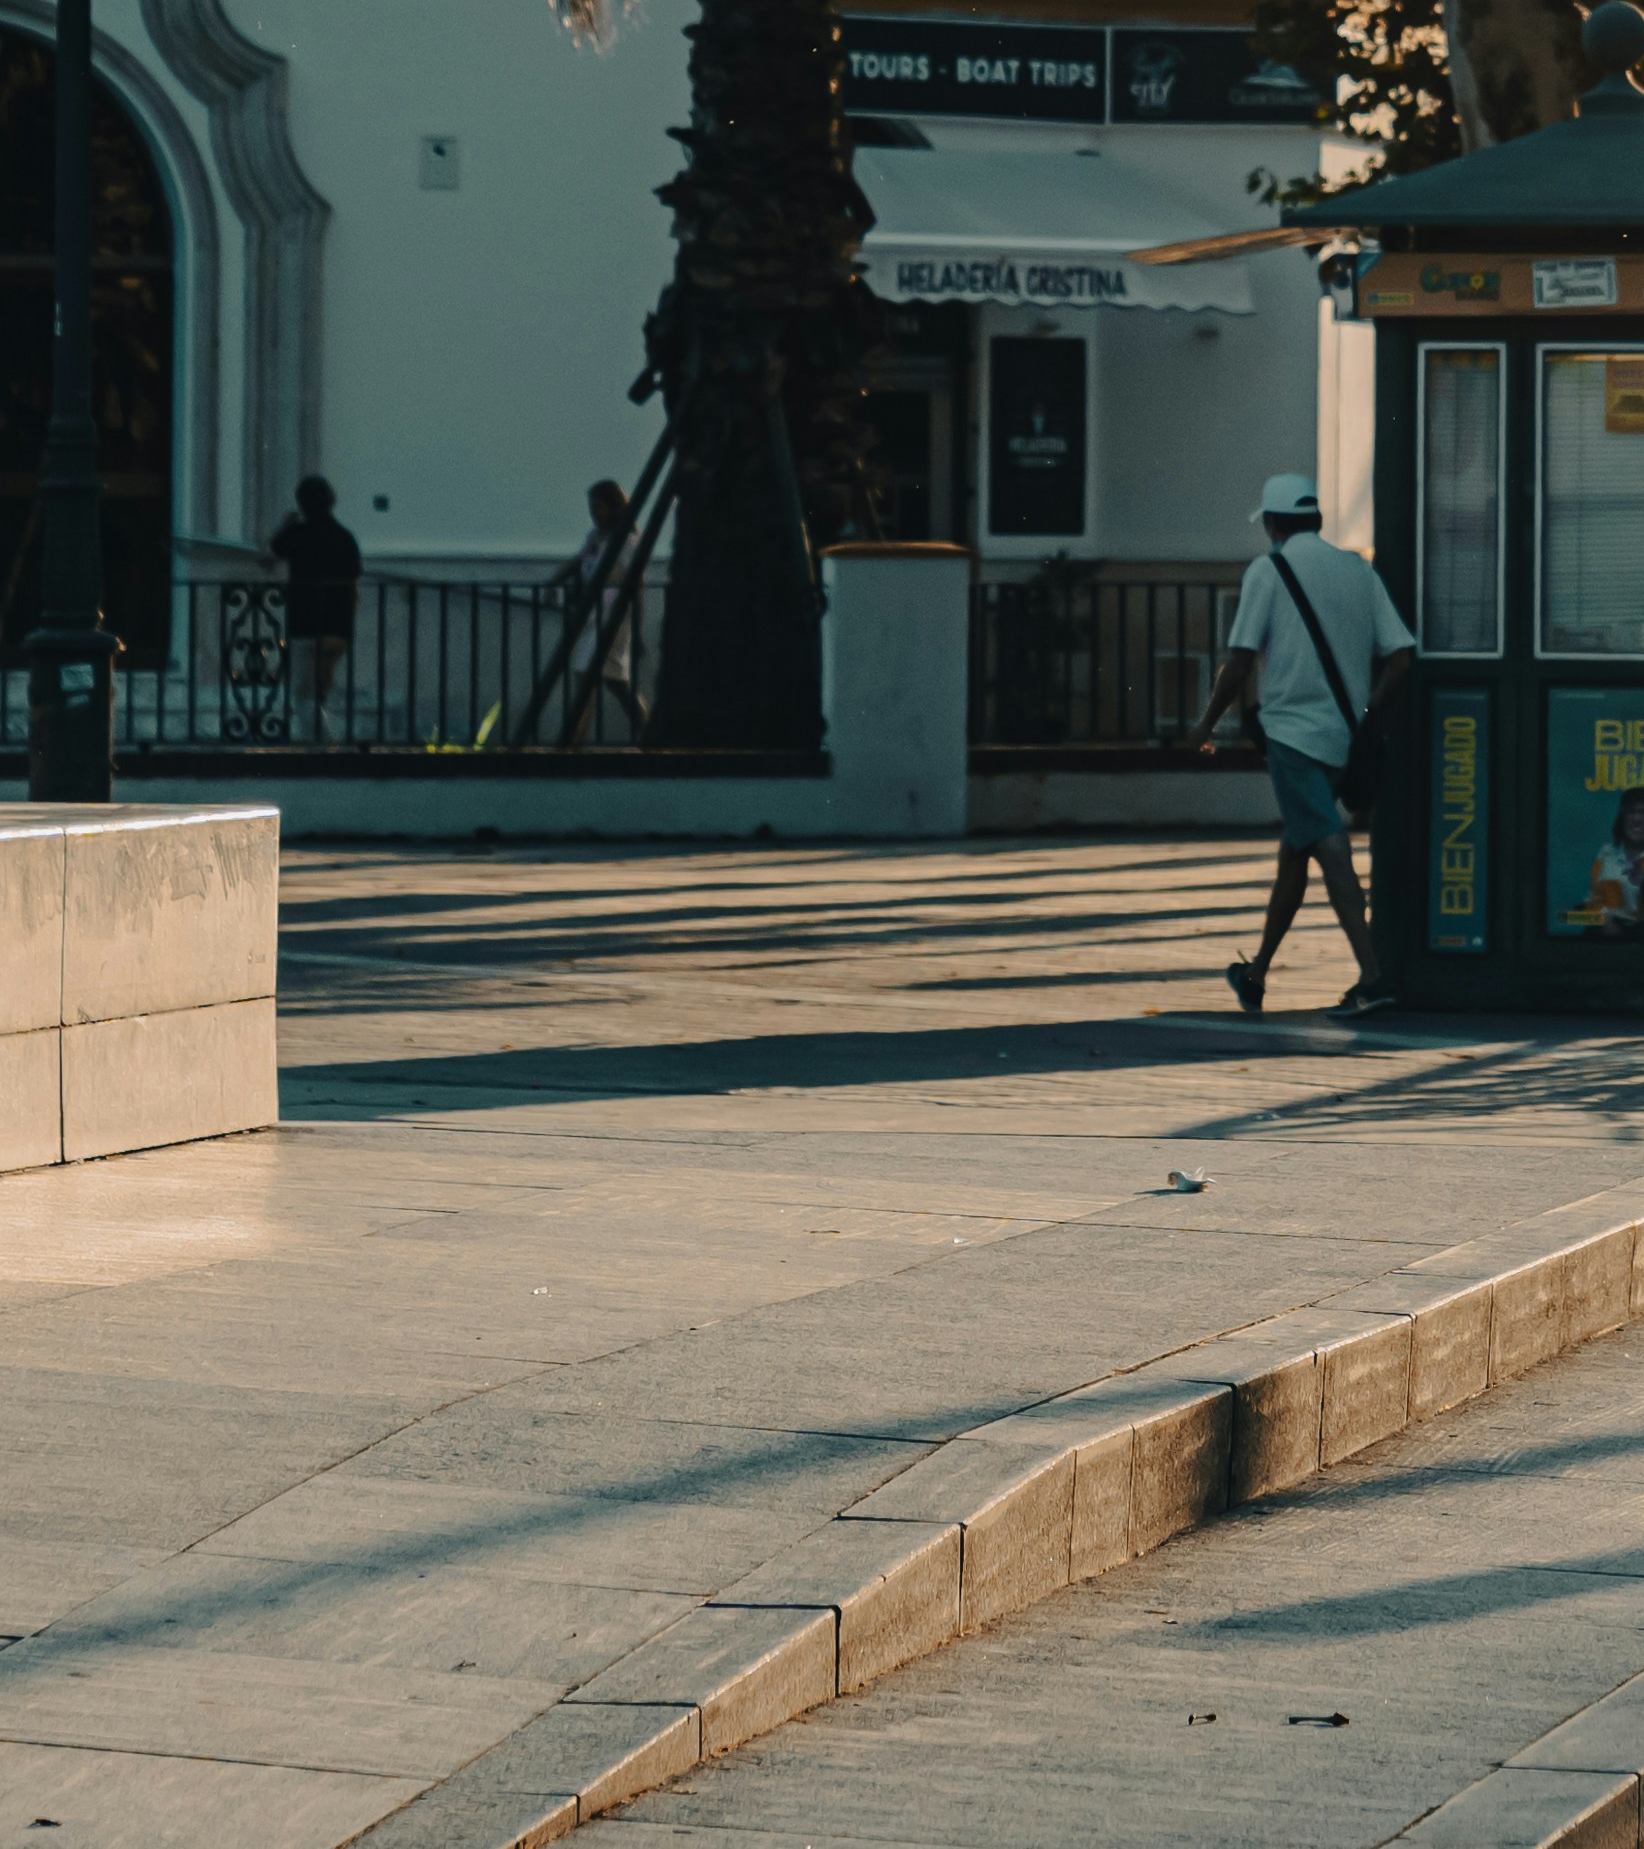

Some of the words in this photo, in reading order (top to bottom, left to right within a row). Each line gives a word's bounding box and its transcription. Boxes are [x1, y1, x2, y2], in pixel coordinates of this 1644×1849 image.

[850, 52, 929, 80] TOURS
[956, 56, 1019, 83] BOAT
[1029, 59, 1096, 87] TRIPS
[1026, 265, 1127, 297] CRISTINA
[1443, 716, 1477, 812] JUGADO
[1441, 813, 1475, 914] BIEN
